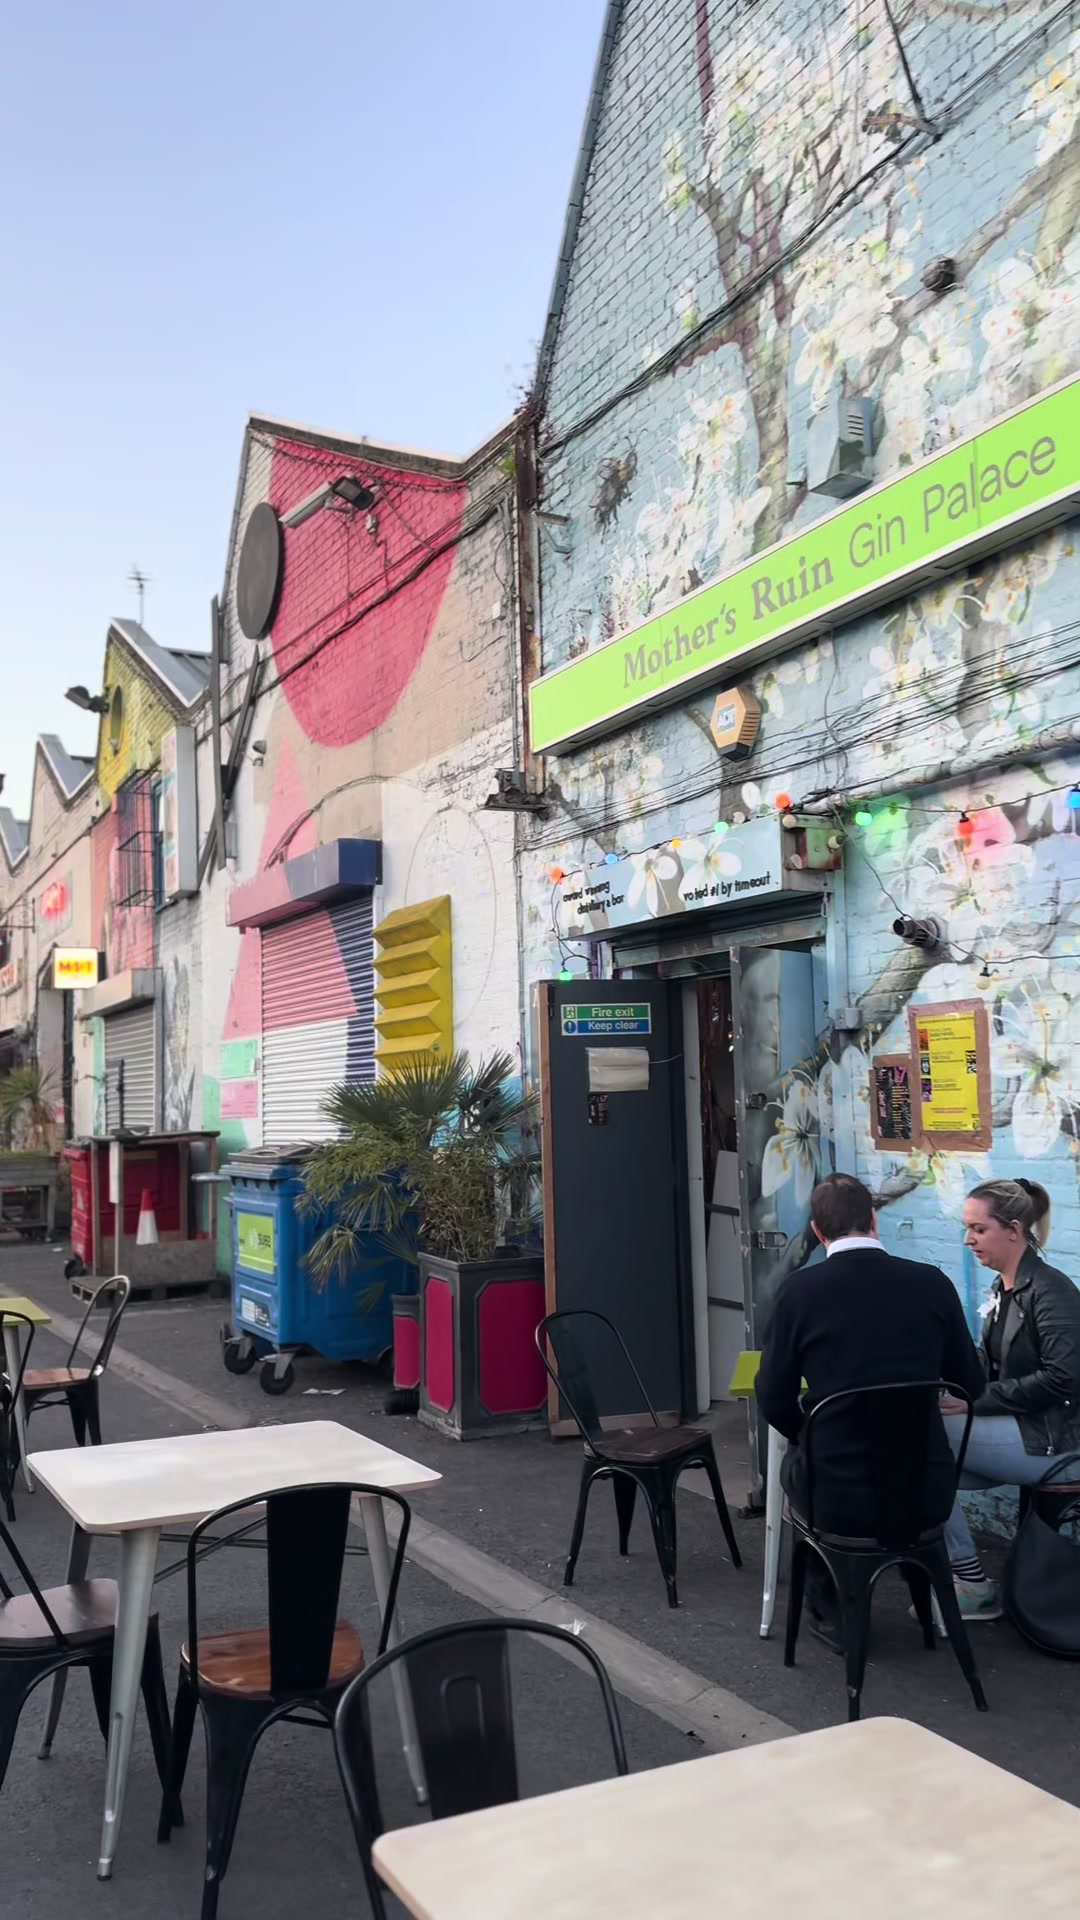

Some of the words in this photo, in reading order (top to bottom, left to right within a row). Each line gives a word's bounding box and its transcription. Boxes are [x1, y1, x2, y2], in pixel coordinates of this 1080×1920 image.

[622, 603, 737, 689] Mother's
[751, 556, 835, 621] Ruin
[848, 514, 907, 568] Gin
[922, 435, 1057, 533] Palace
[721, 881, 733, 898] by
[611, 893, 625, 906] bar
[591, 1007, 613, 1017] Fire
[615, 1006, 635, 1017] exit
[588, 1020, 613, 1032] Keep
[614, 1019, 639, 1030] clear
